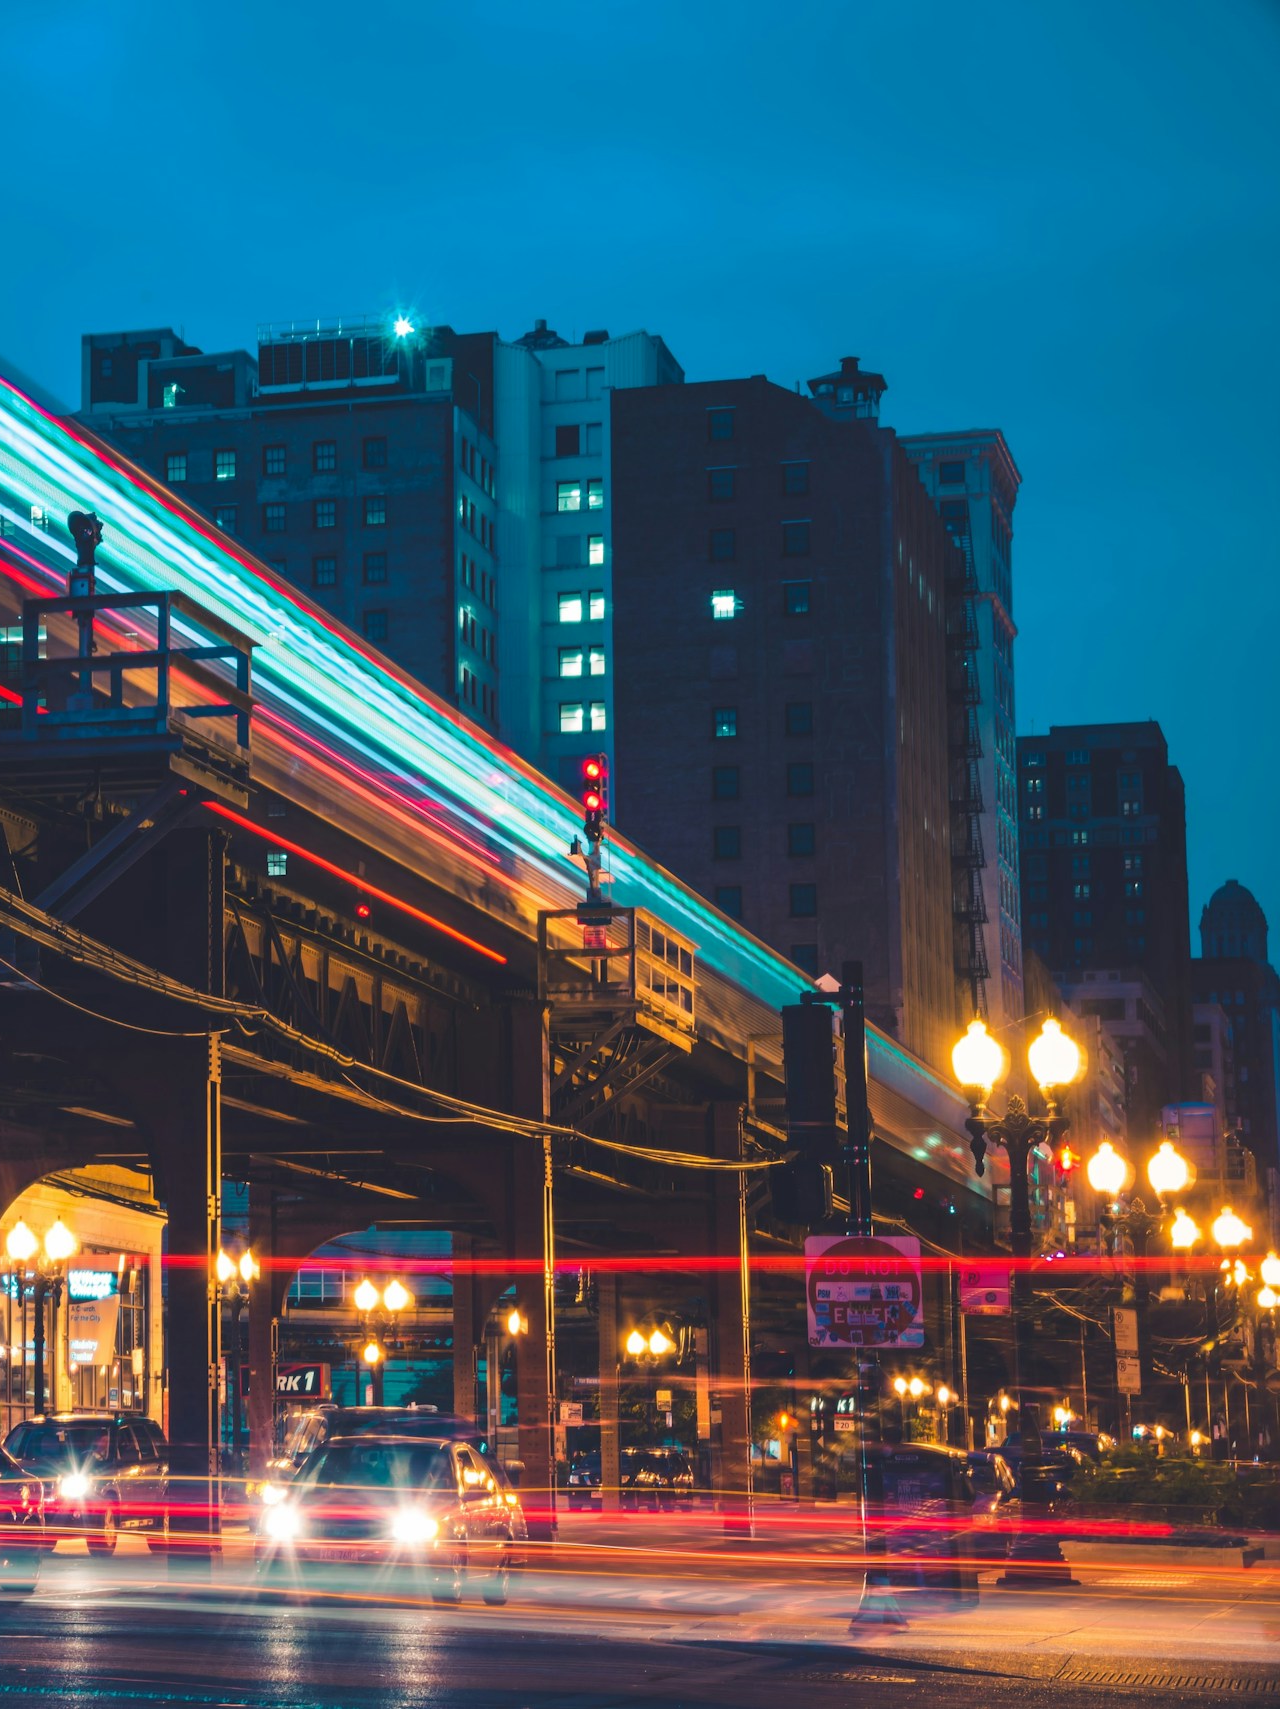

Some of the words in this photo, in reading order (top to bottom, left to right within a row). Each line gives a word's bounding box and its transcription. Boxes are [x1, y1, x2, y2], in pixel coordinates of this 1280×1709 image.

[825, 1259, 850, 1276] DO
[865, 1259, 900, 1276] NOT
[834, 1307, 896, 1324] EER
[305, 1371, 315, 1391] 1
